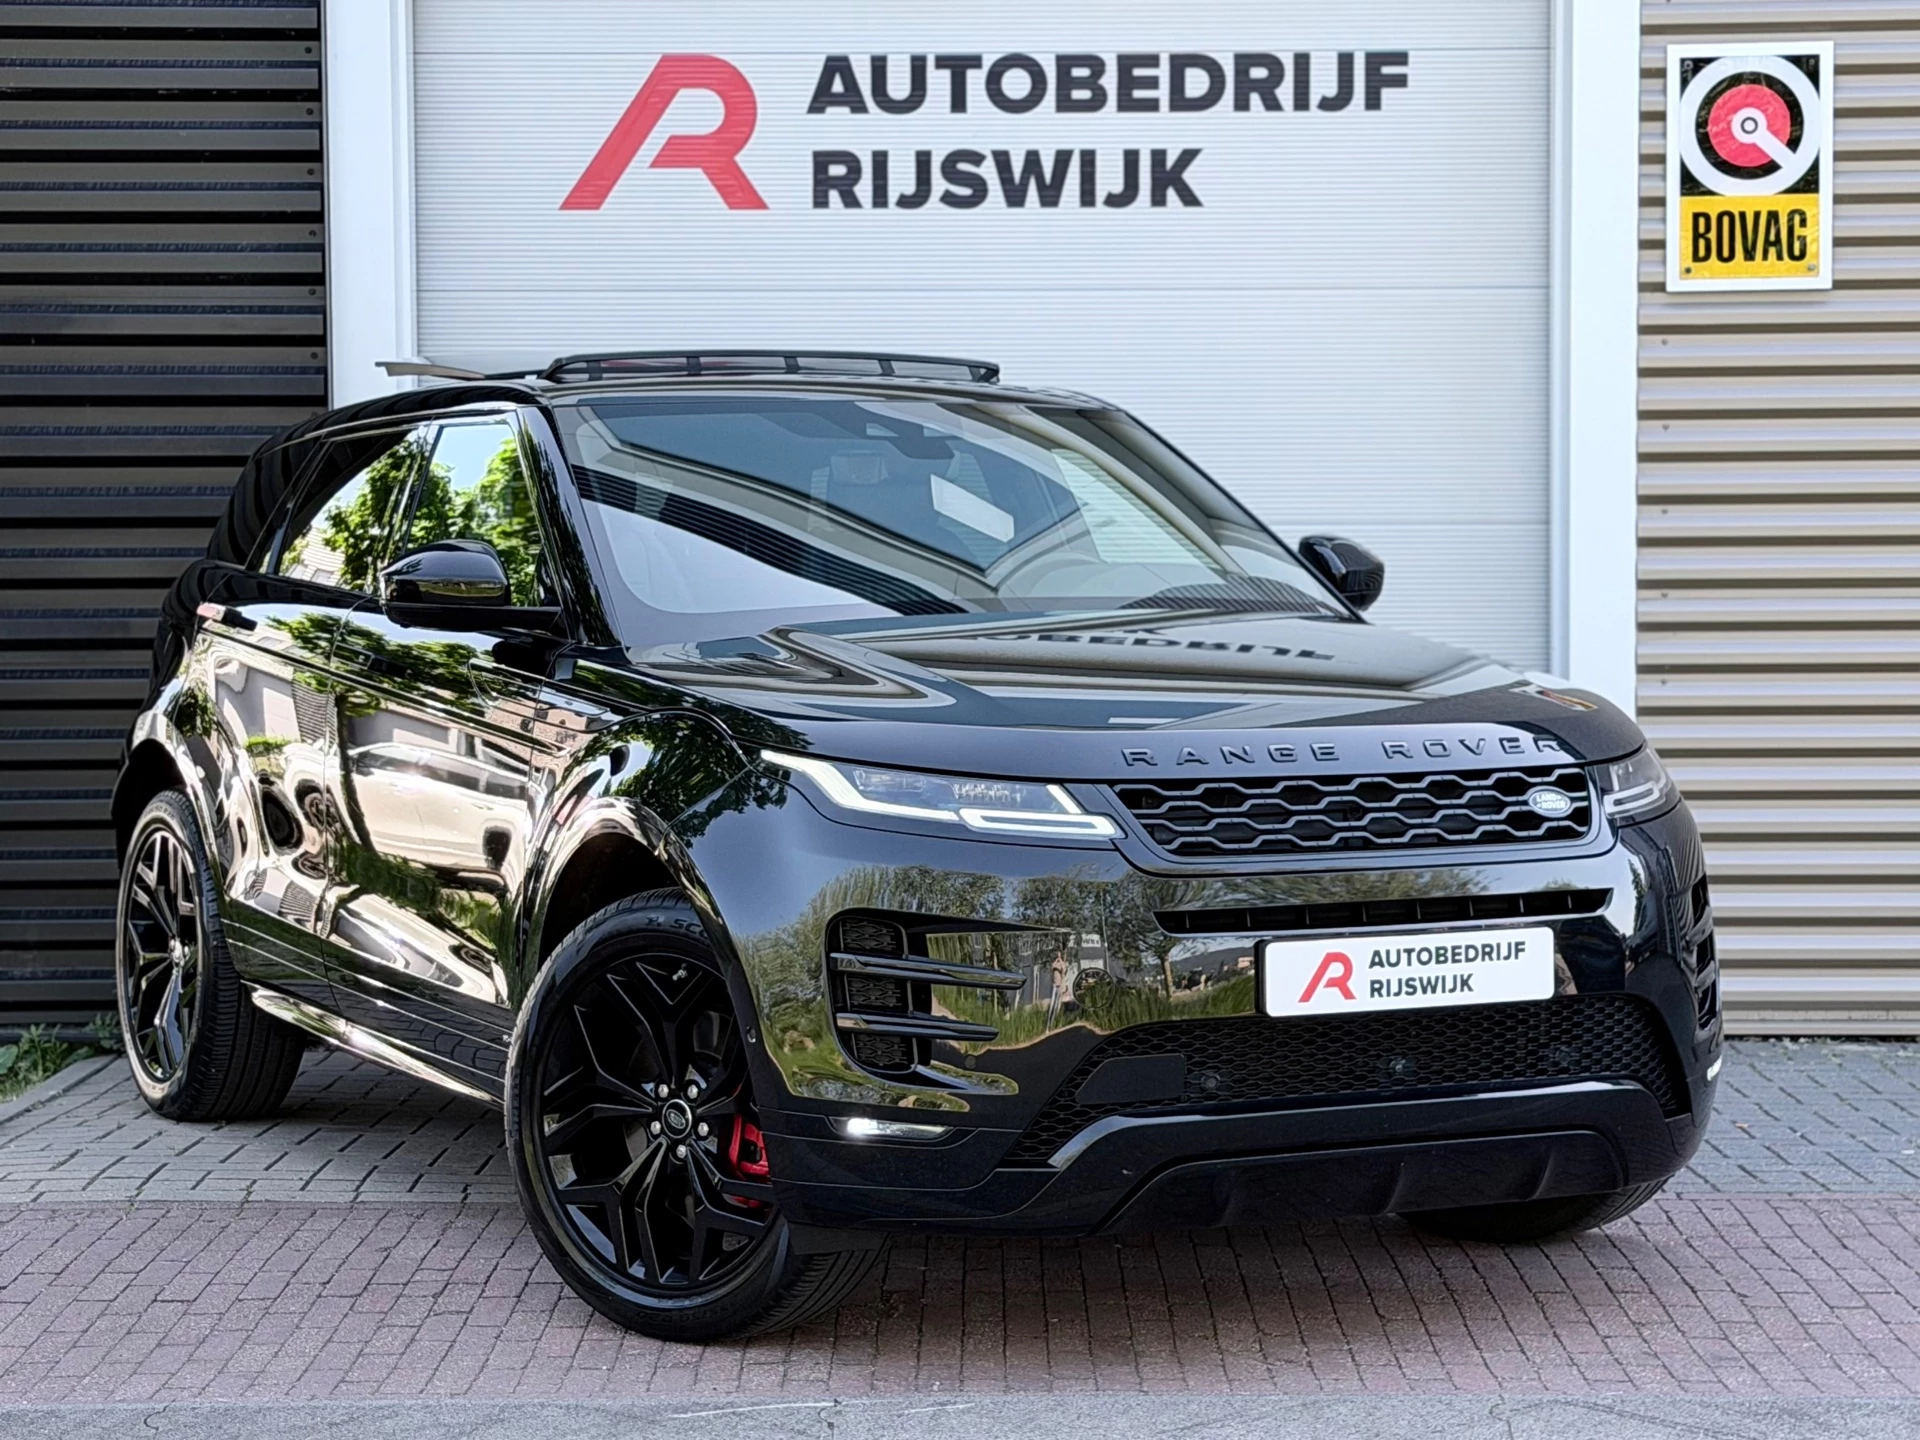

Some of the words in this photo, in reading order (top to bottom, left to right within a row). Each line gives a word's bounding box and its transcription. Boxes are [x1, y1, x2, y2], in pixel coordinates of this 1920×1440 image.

[806, 51, 1409, 115] AUTOBEDRIJF
[812, 148, 1205, 210] RIJSWIJK
[1691, 209, 1807, 264] BOVAG
[1121, 743, 1340, 766] RANGE
[1381, 736, 1560, 759] ROVER
[1368, 941, 1526, 969] AUTOBEDRIJF
[1369, 973, 1474, 998] RIJSWIJK
